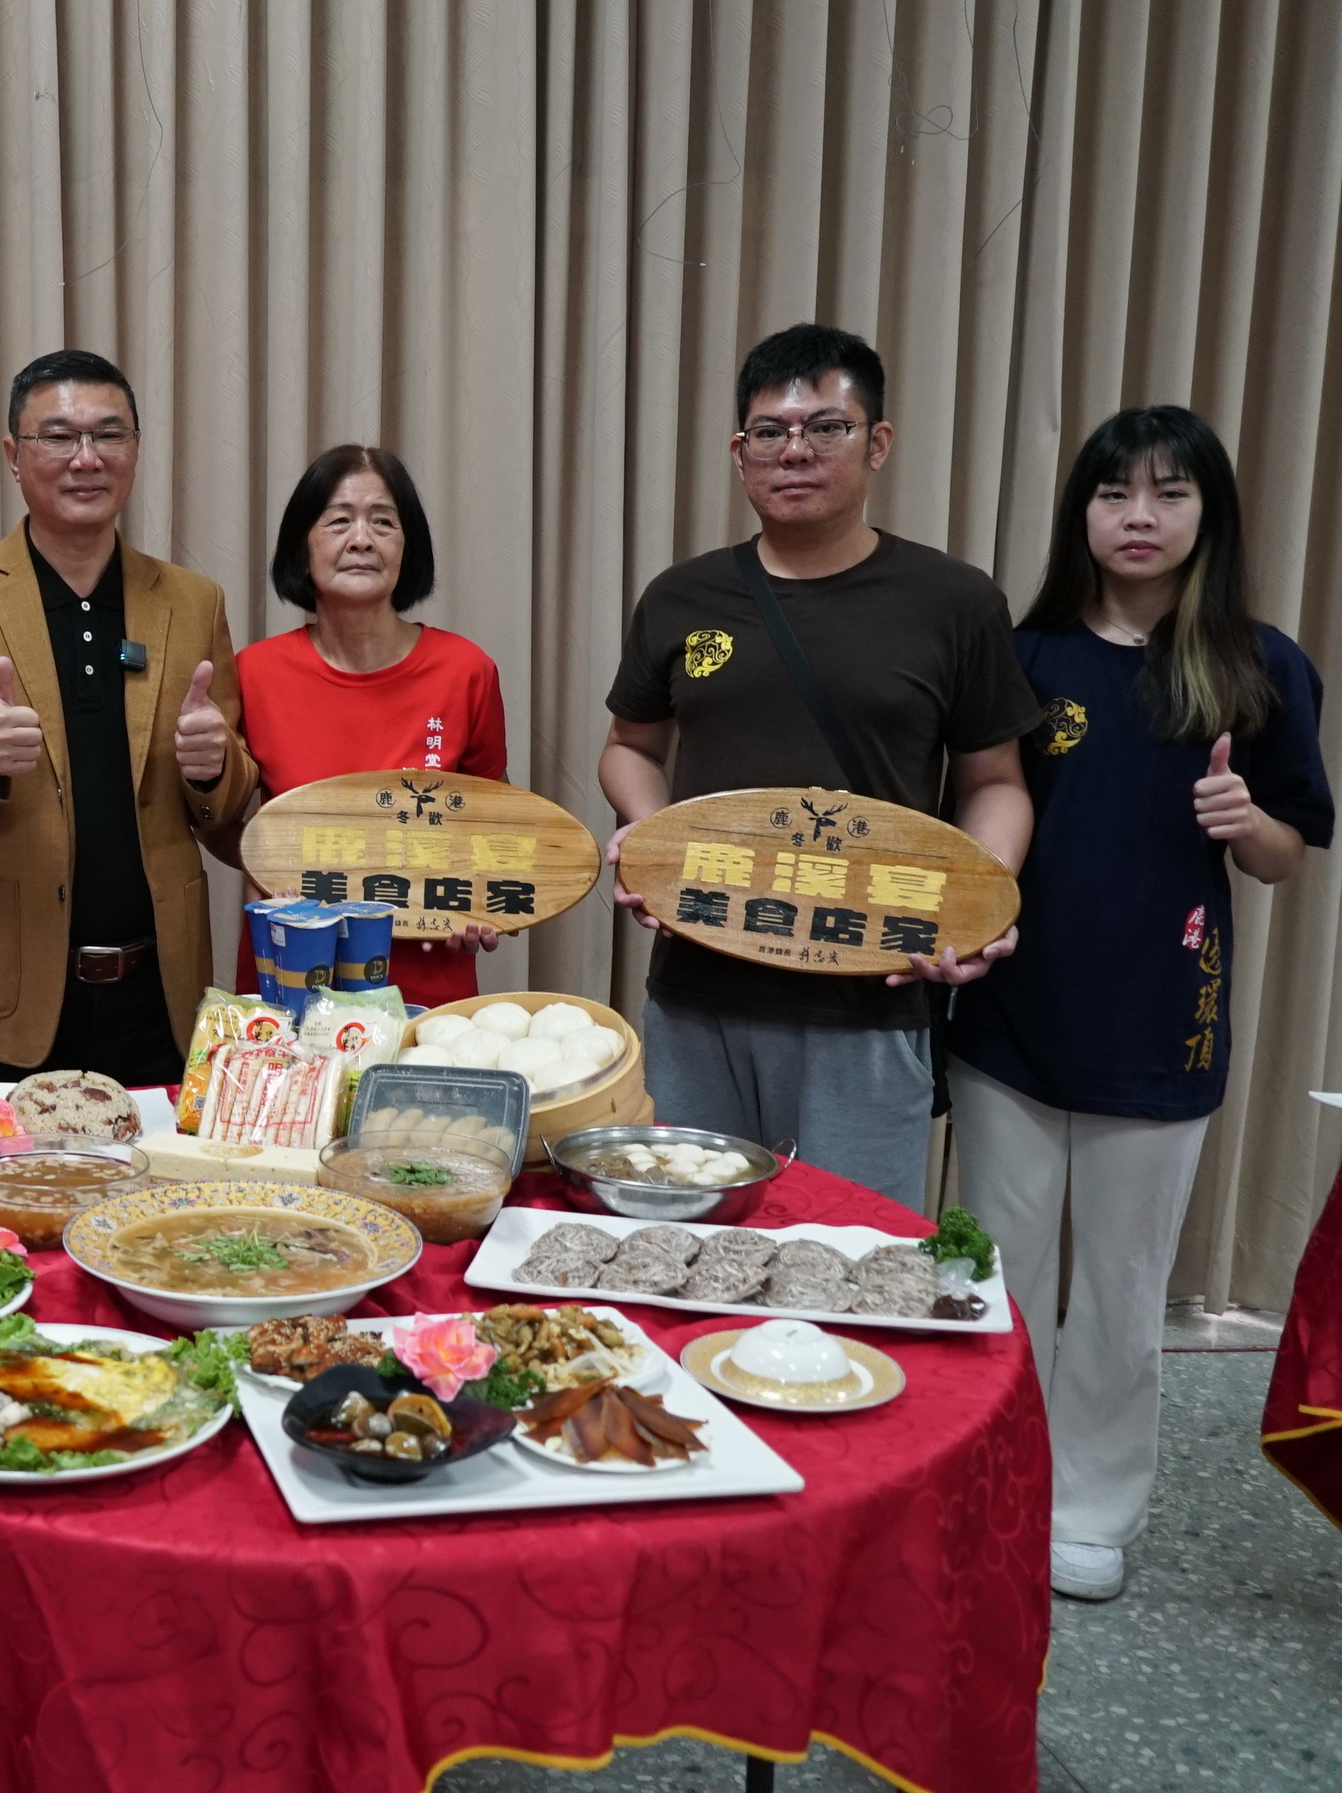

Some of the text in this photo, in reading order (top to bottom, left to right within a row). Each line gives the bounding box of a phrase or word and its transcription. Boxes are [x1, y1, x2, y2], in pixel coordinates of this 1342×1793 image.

[424, 716, 445, 771] 林明堂
[300, 870, 536, 915] 美食店家
[675, 886, 941, 957] 美食店家
[1181, 903, 1206, 950] 鹿港
